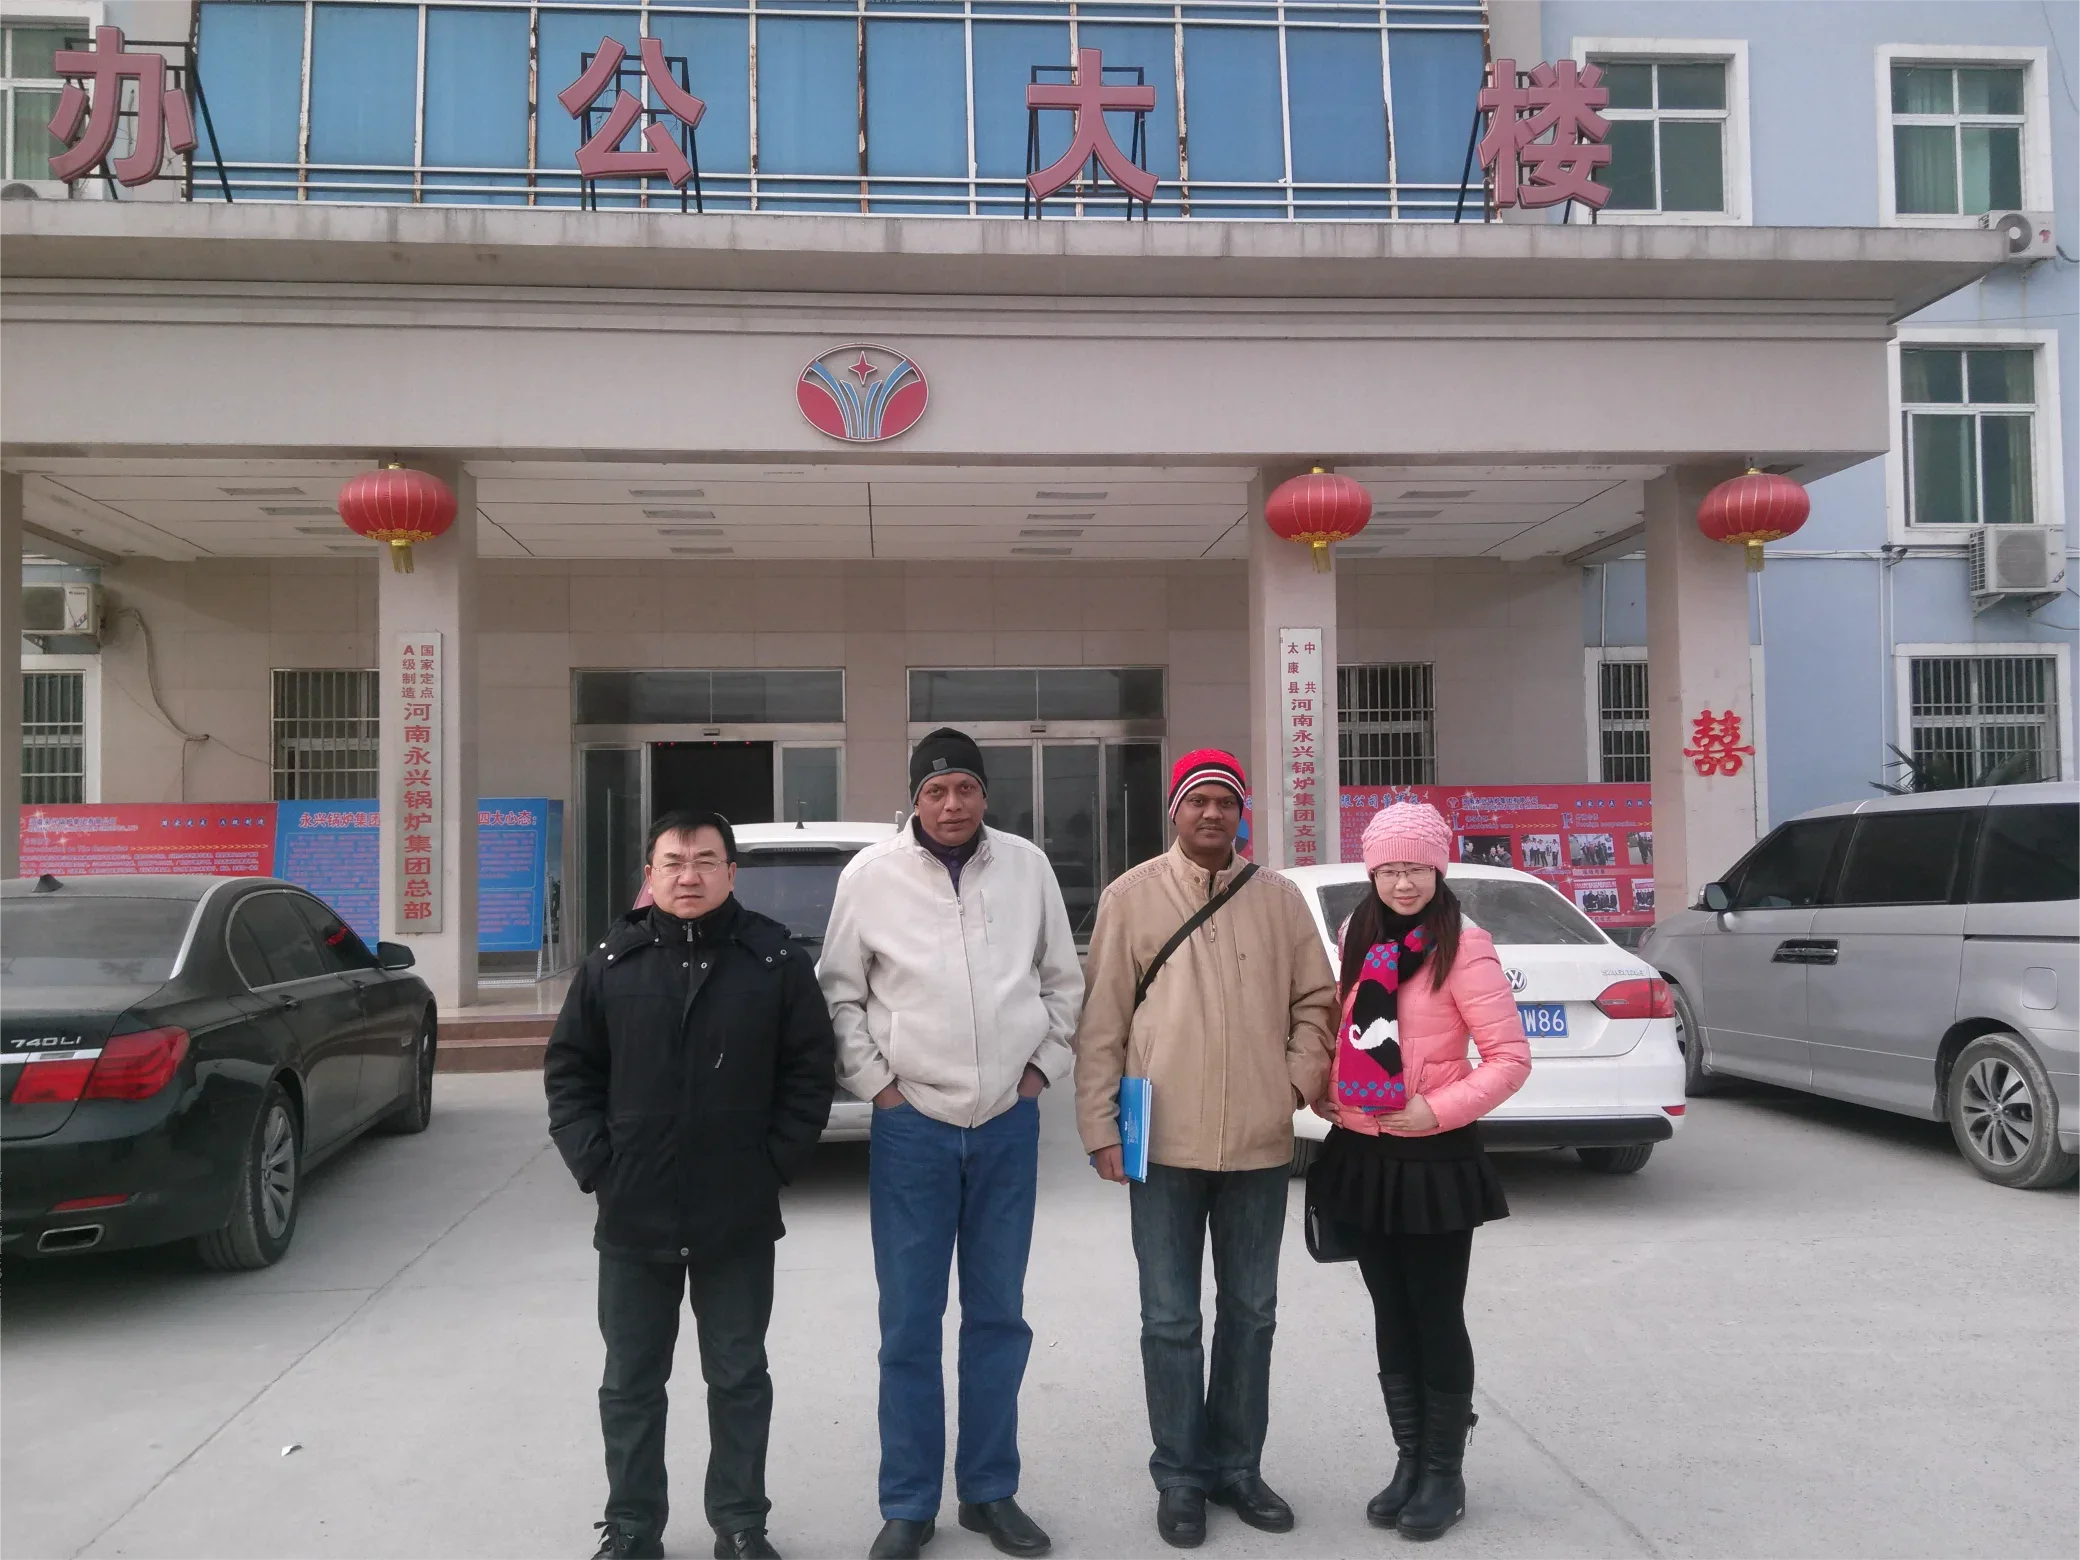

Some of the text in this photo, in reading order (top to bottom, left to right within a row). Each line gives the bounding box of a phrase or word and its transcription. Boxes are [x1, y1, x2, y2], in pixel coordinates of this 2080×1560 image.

[48, 25, 1613, 209] 办公大楼
[402, 645, 416, 698] A级制造
[420, 644, 434, 698] 国家定点
[1288, 642, 1300, 694] 太康县
[1304, 642, 1316, 694] 中共
[299, 811, 380, 828] 永兴锅炉集团
[404, 703, 432, 919] 河南永兴锅炉集团总部
[1518, 1009, 1564, 1032] W86
